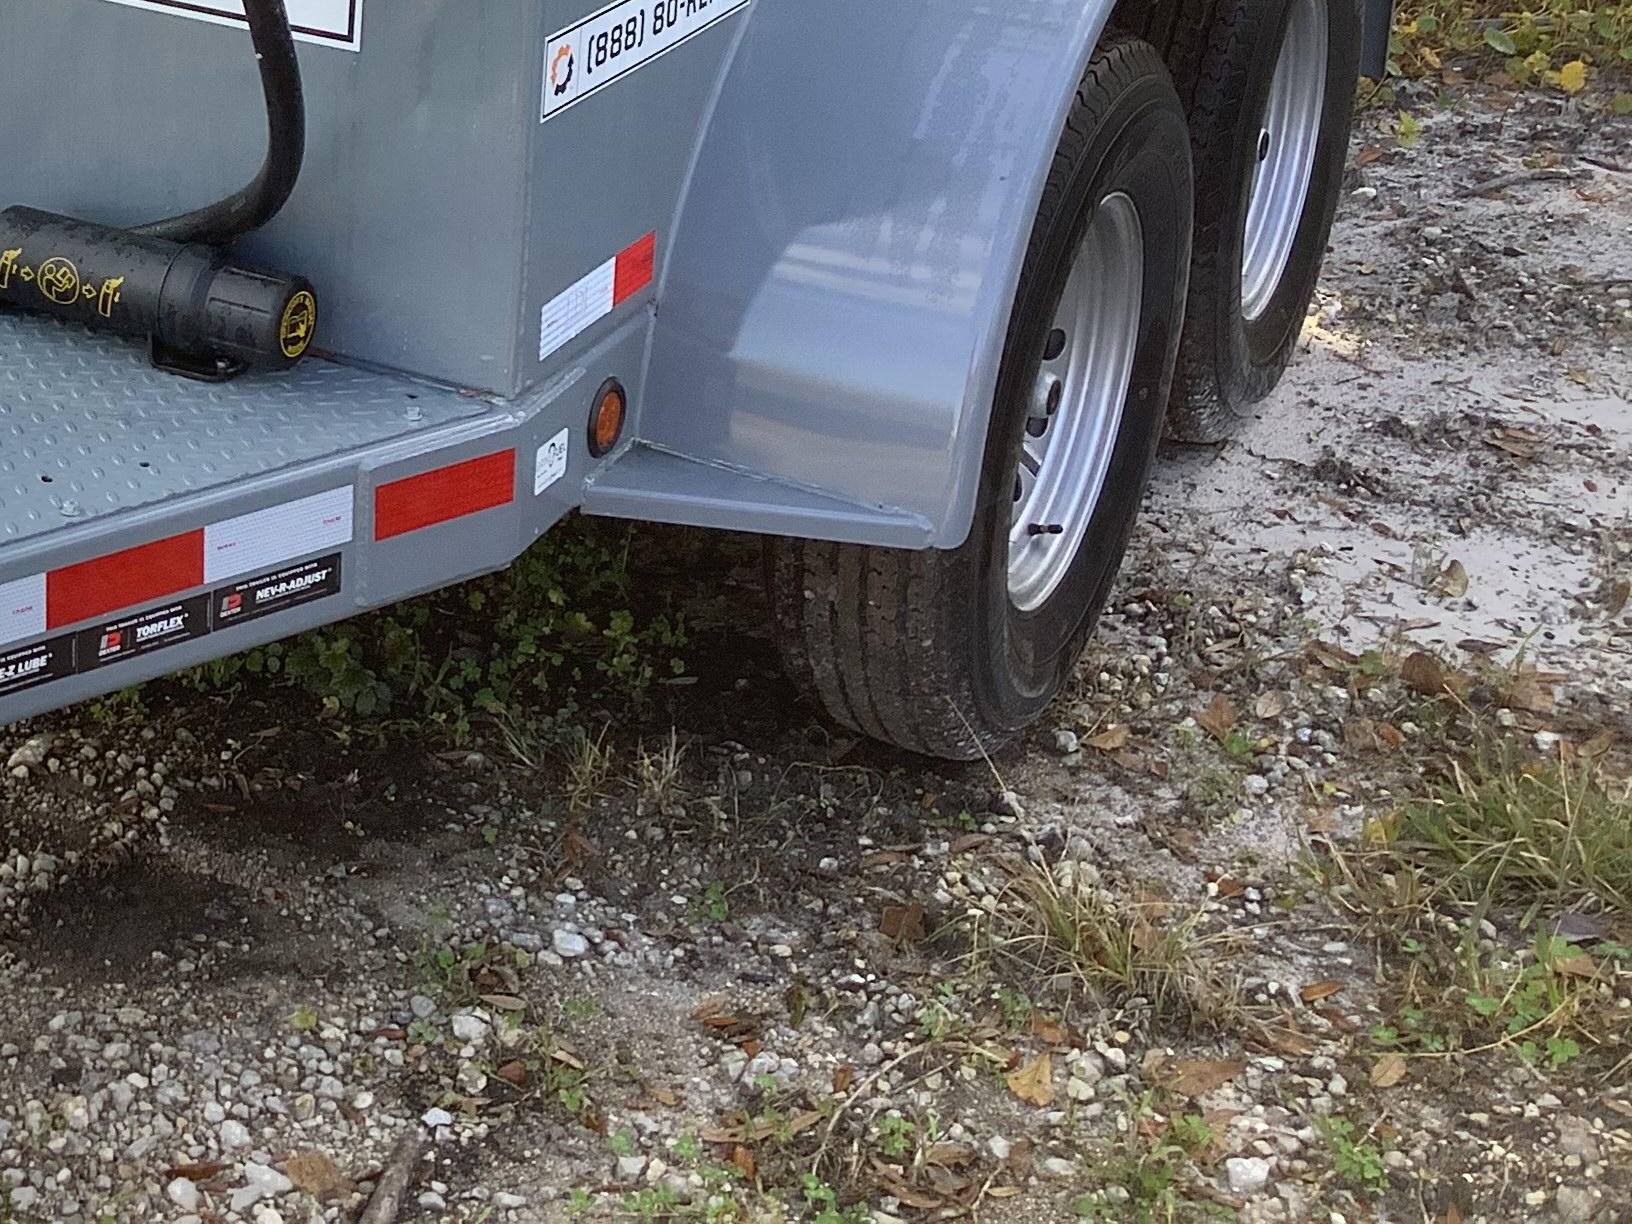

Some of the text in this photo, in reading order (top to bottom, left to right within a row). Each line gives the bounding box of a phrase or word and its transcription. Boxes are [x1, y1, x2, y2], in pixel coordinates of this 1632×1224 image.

[586, 8, 645, 75] (888)
[255, 570, 328, 600] NEV-R-ADJUST
[136, 615, 184, 638] TORFLEX
[17, 655, 48, 674] LUBE
